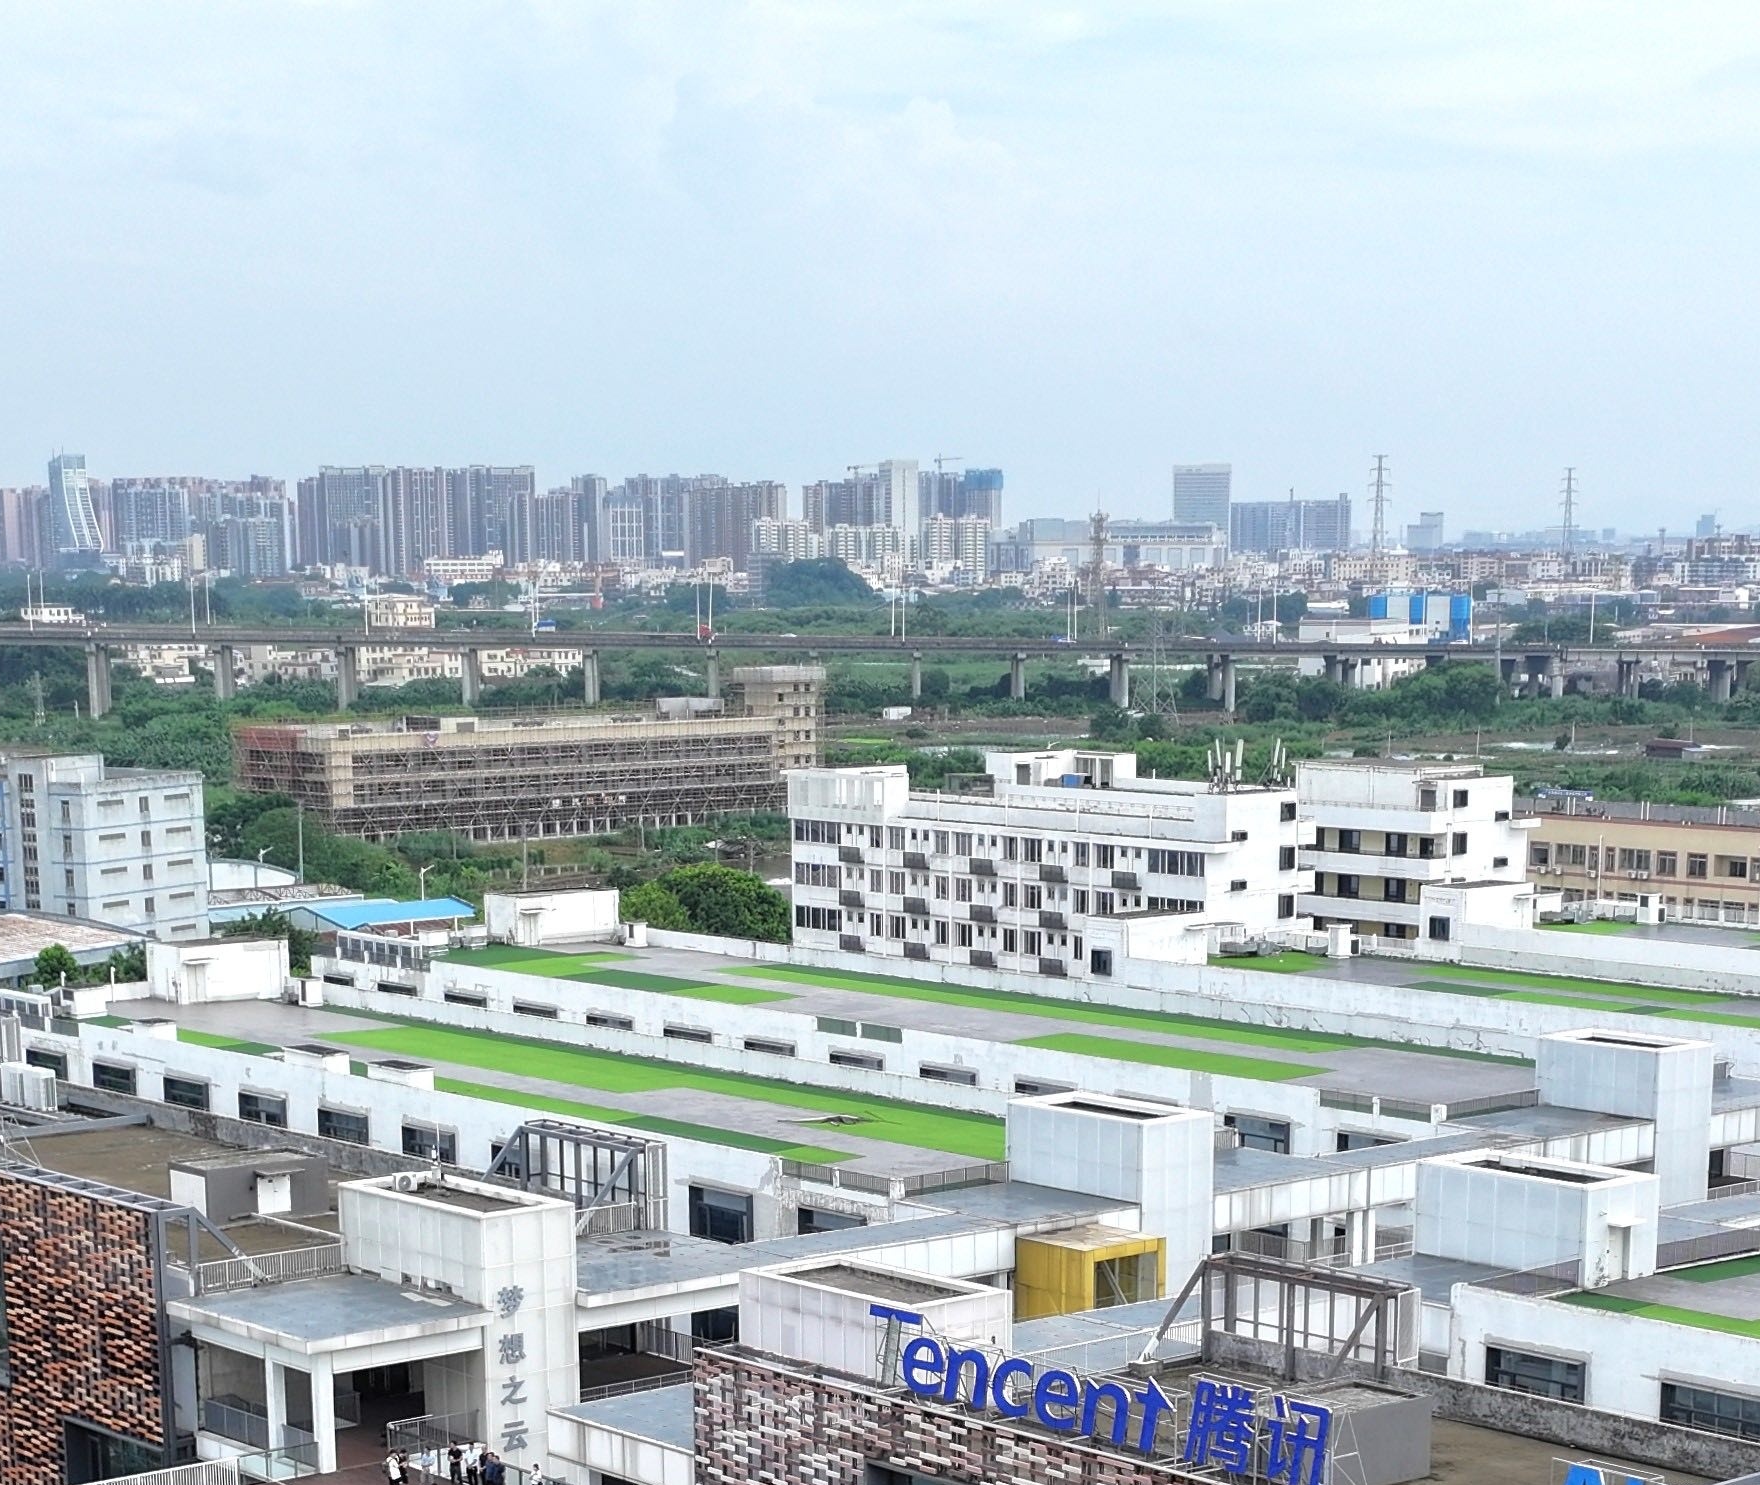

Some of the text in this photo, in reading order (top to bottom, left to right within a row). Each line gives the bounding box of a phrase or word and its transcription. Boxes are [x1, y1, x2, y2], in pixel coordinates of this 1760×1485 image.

[497, 1285, 529, 1452] 梦想之云
[870, 1304, 1177, 1453] Tencent
